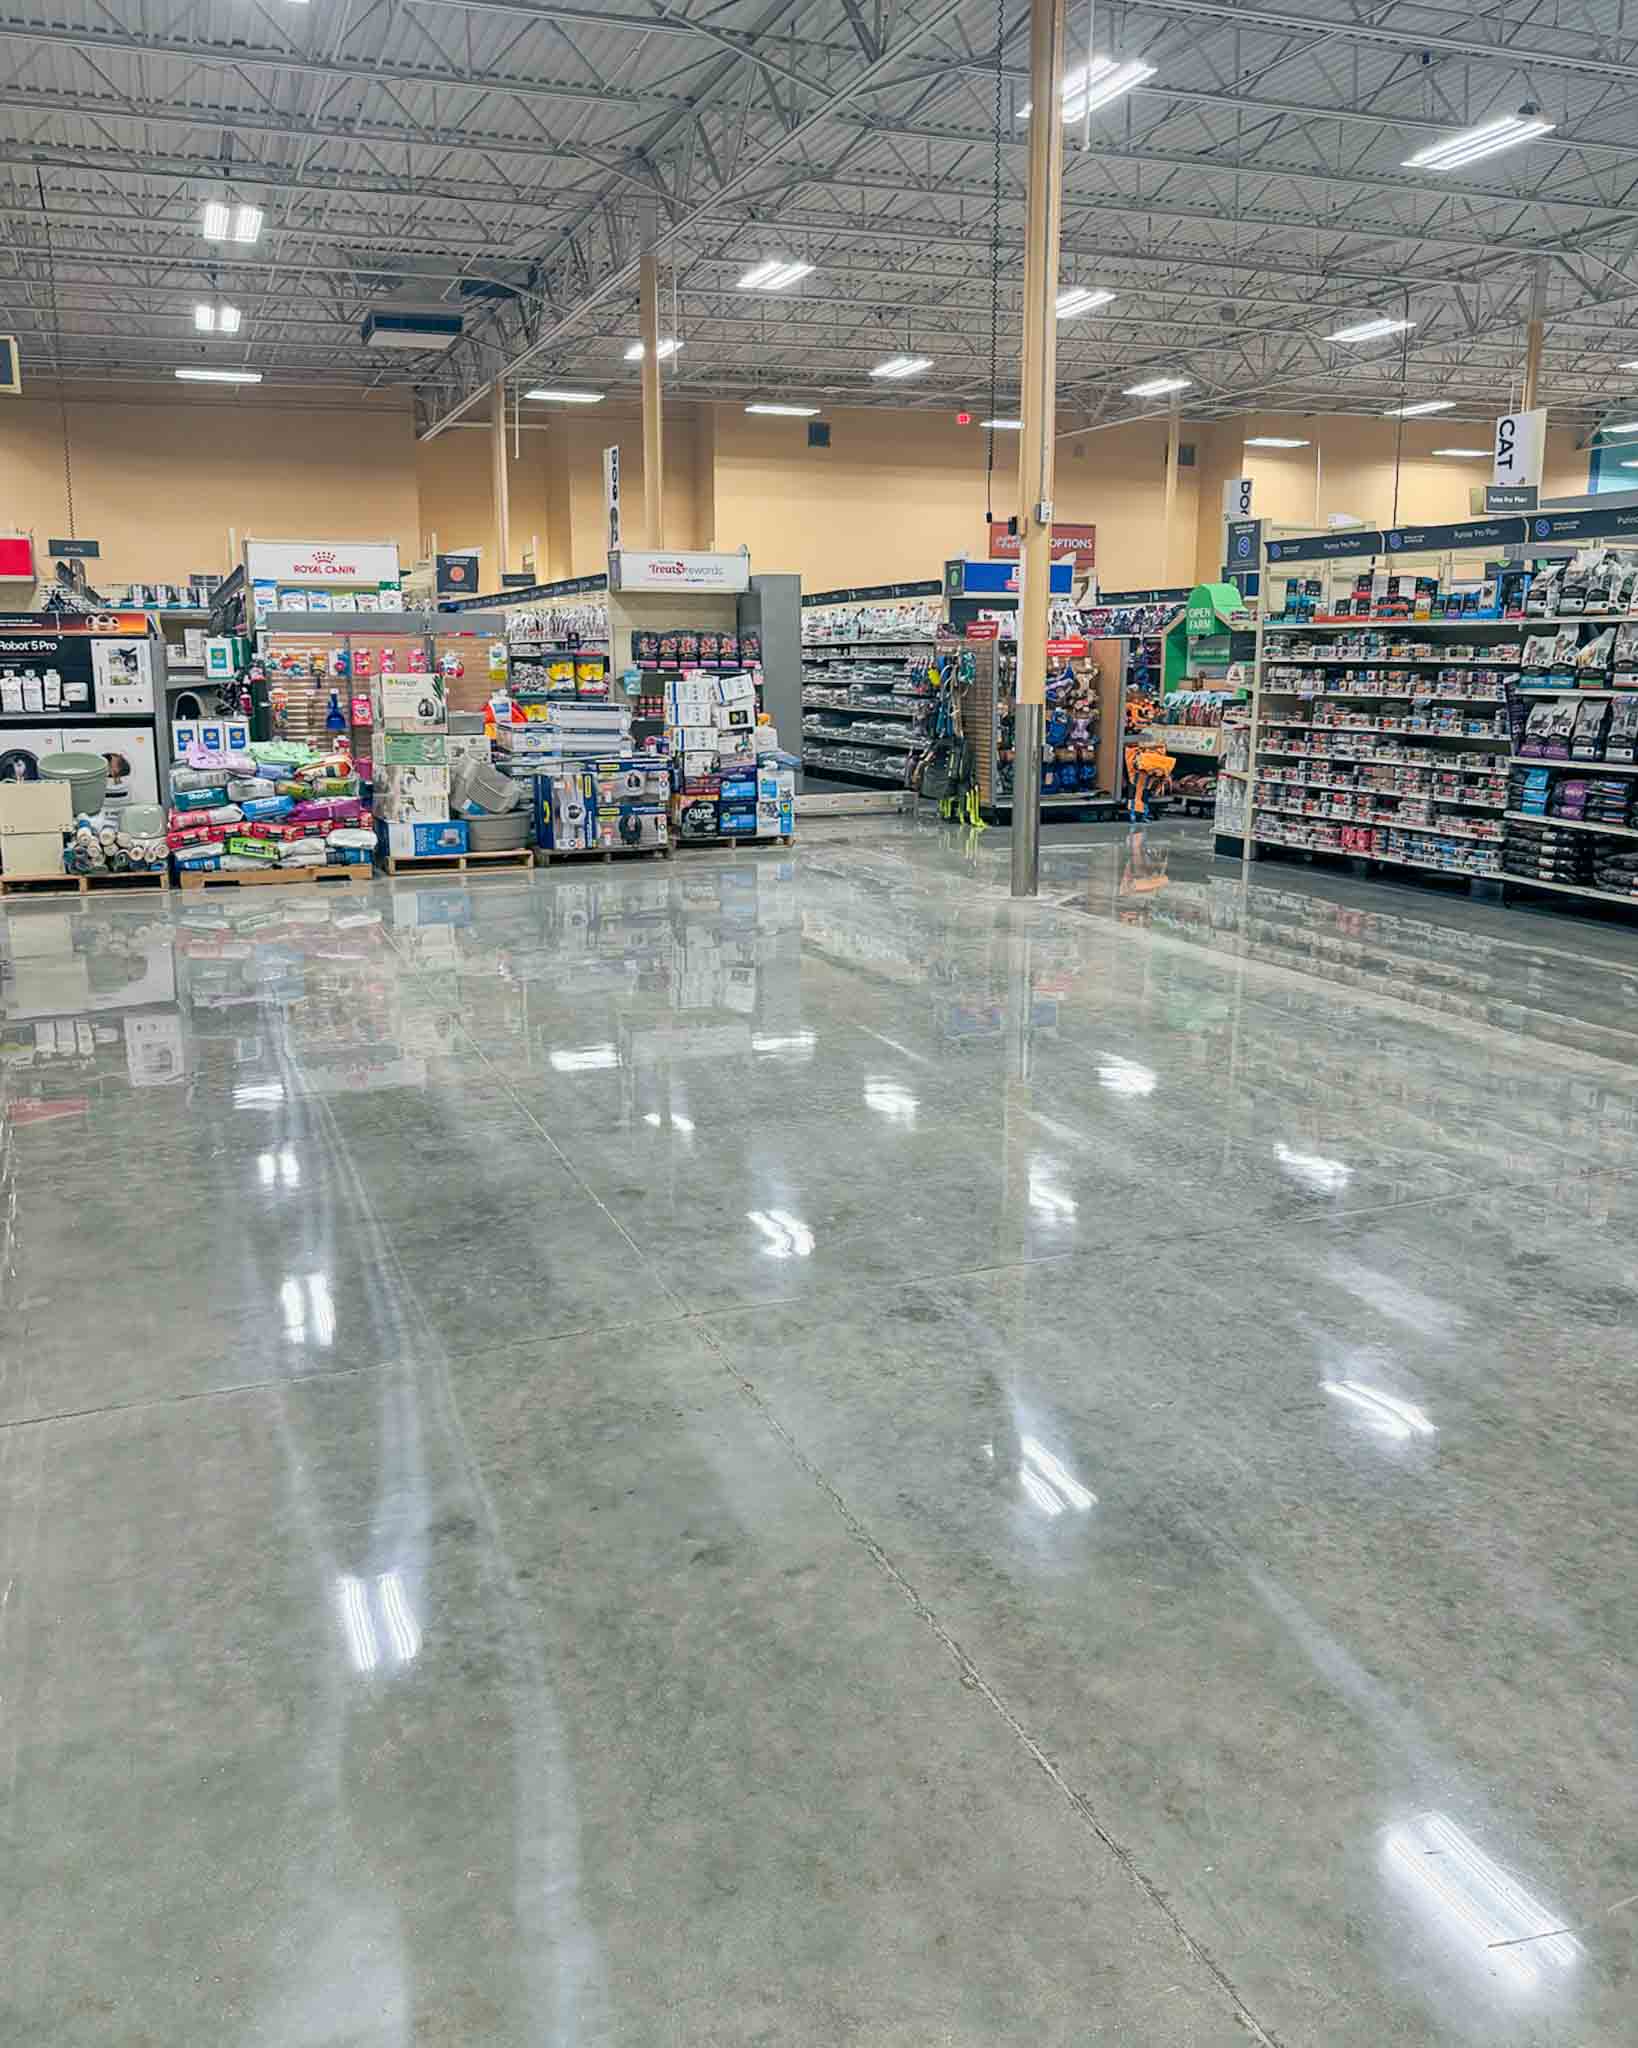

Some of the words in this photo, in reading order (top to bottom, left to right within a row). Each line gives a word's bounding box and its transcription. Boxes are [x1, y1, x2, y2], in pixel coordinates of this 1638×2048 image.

[1497, 418, 1515, 470] CAT
[1049, 536, 1093, 549] OPTIONS
[293, 565, 322, 574] ROYAL
[325, 565, 356, 574] CANIN
[1189, 608, 1210, 618] OPEN
[31, 640, 39, 651] 5
[40, 640, 58, 651] Pro
